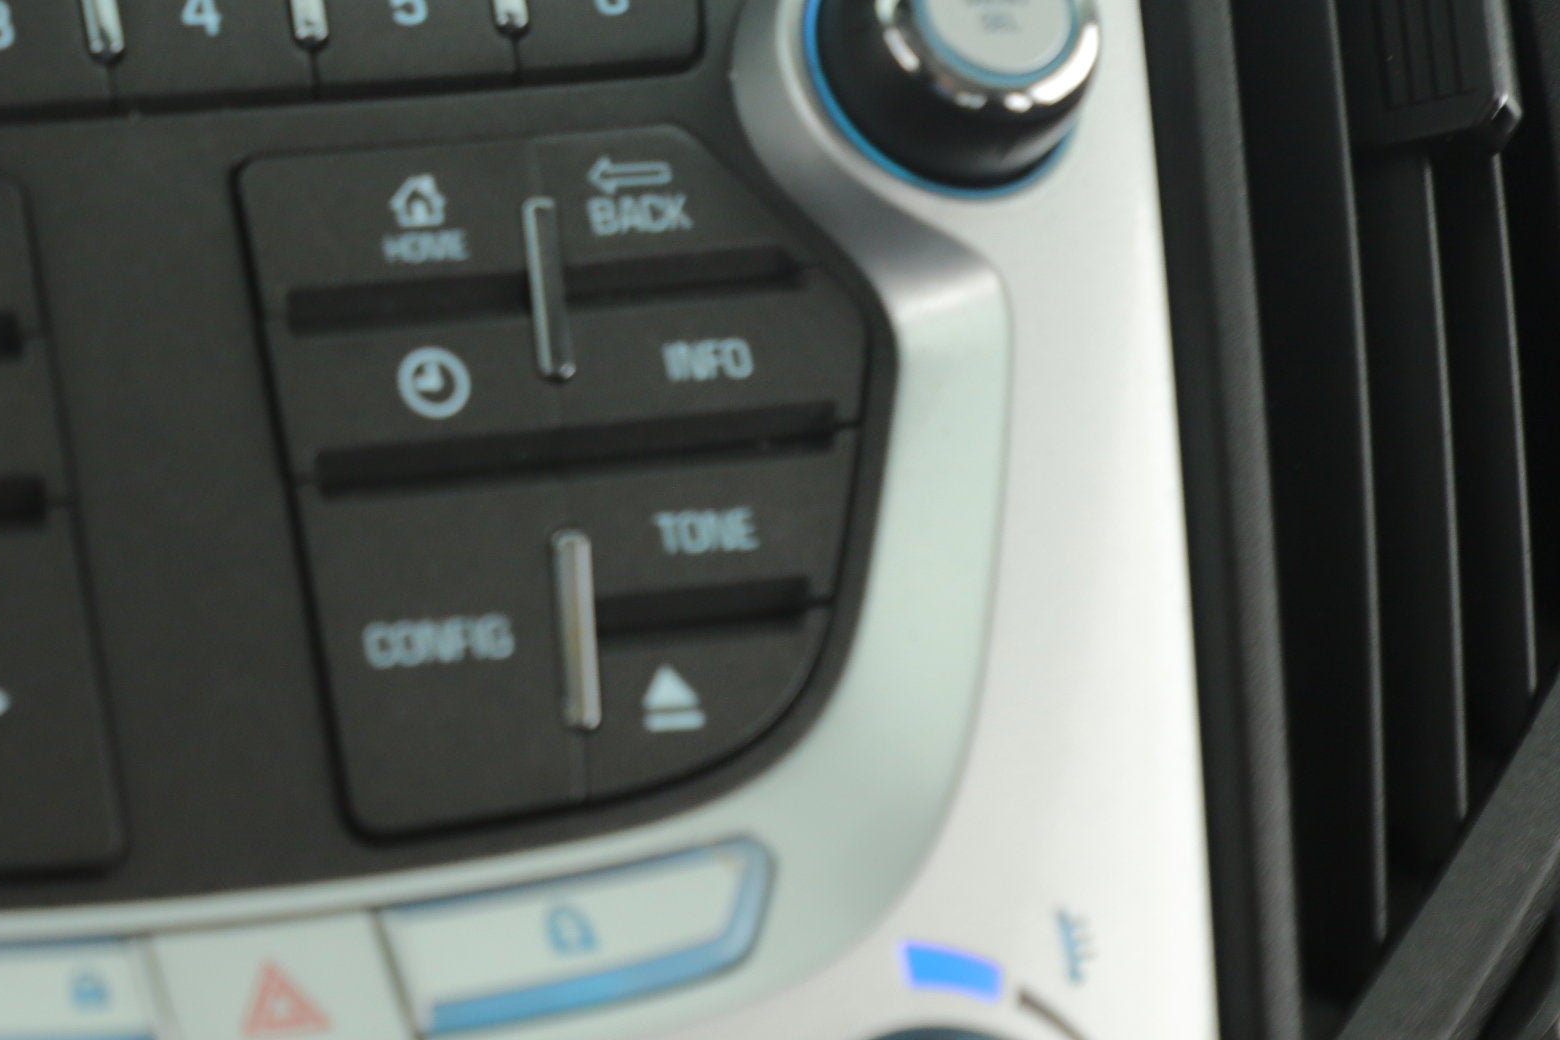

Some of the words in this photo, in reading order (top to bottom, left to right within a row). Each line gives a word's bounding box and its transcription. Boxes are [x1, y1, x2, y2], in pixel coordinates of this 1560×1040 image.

[586, 194, 692, 237] BACK
[662, 337, 755, 382] INFO
[653, 507, 759, 554] TONE
[362, 613, 516, 670] CONFIG
